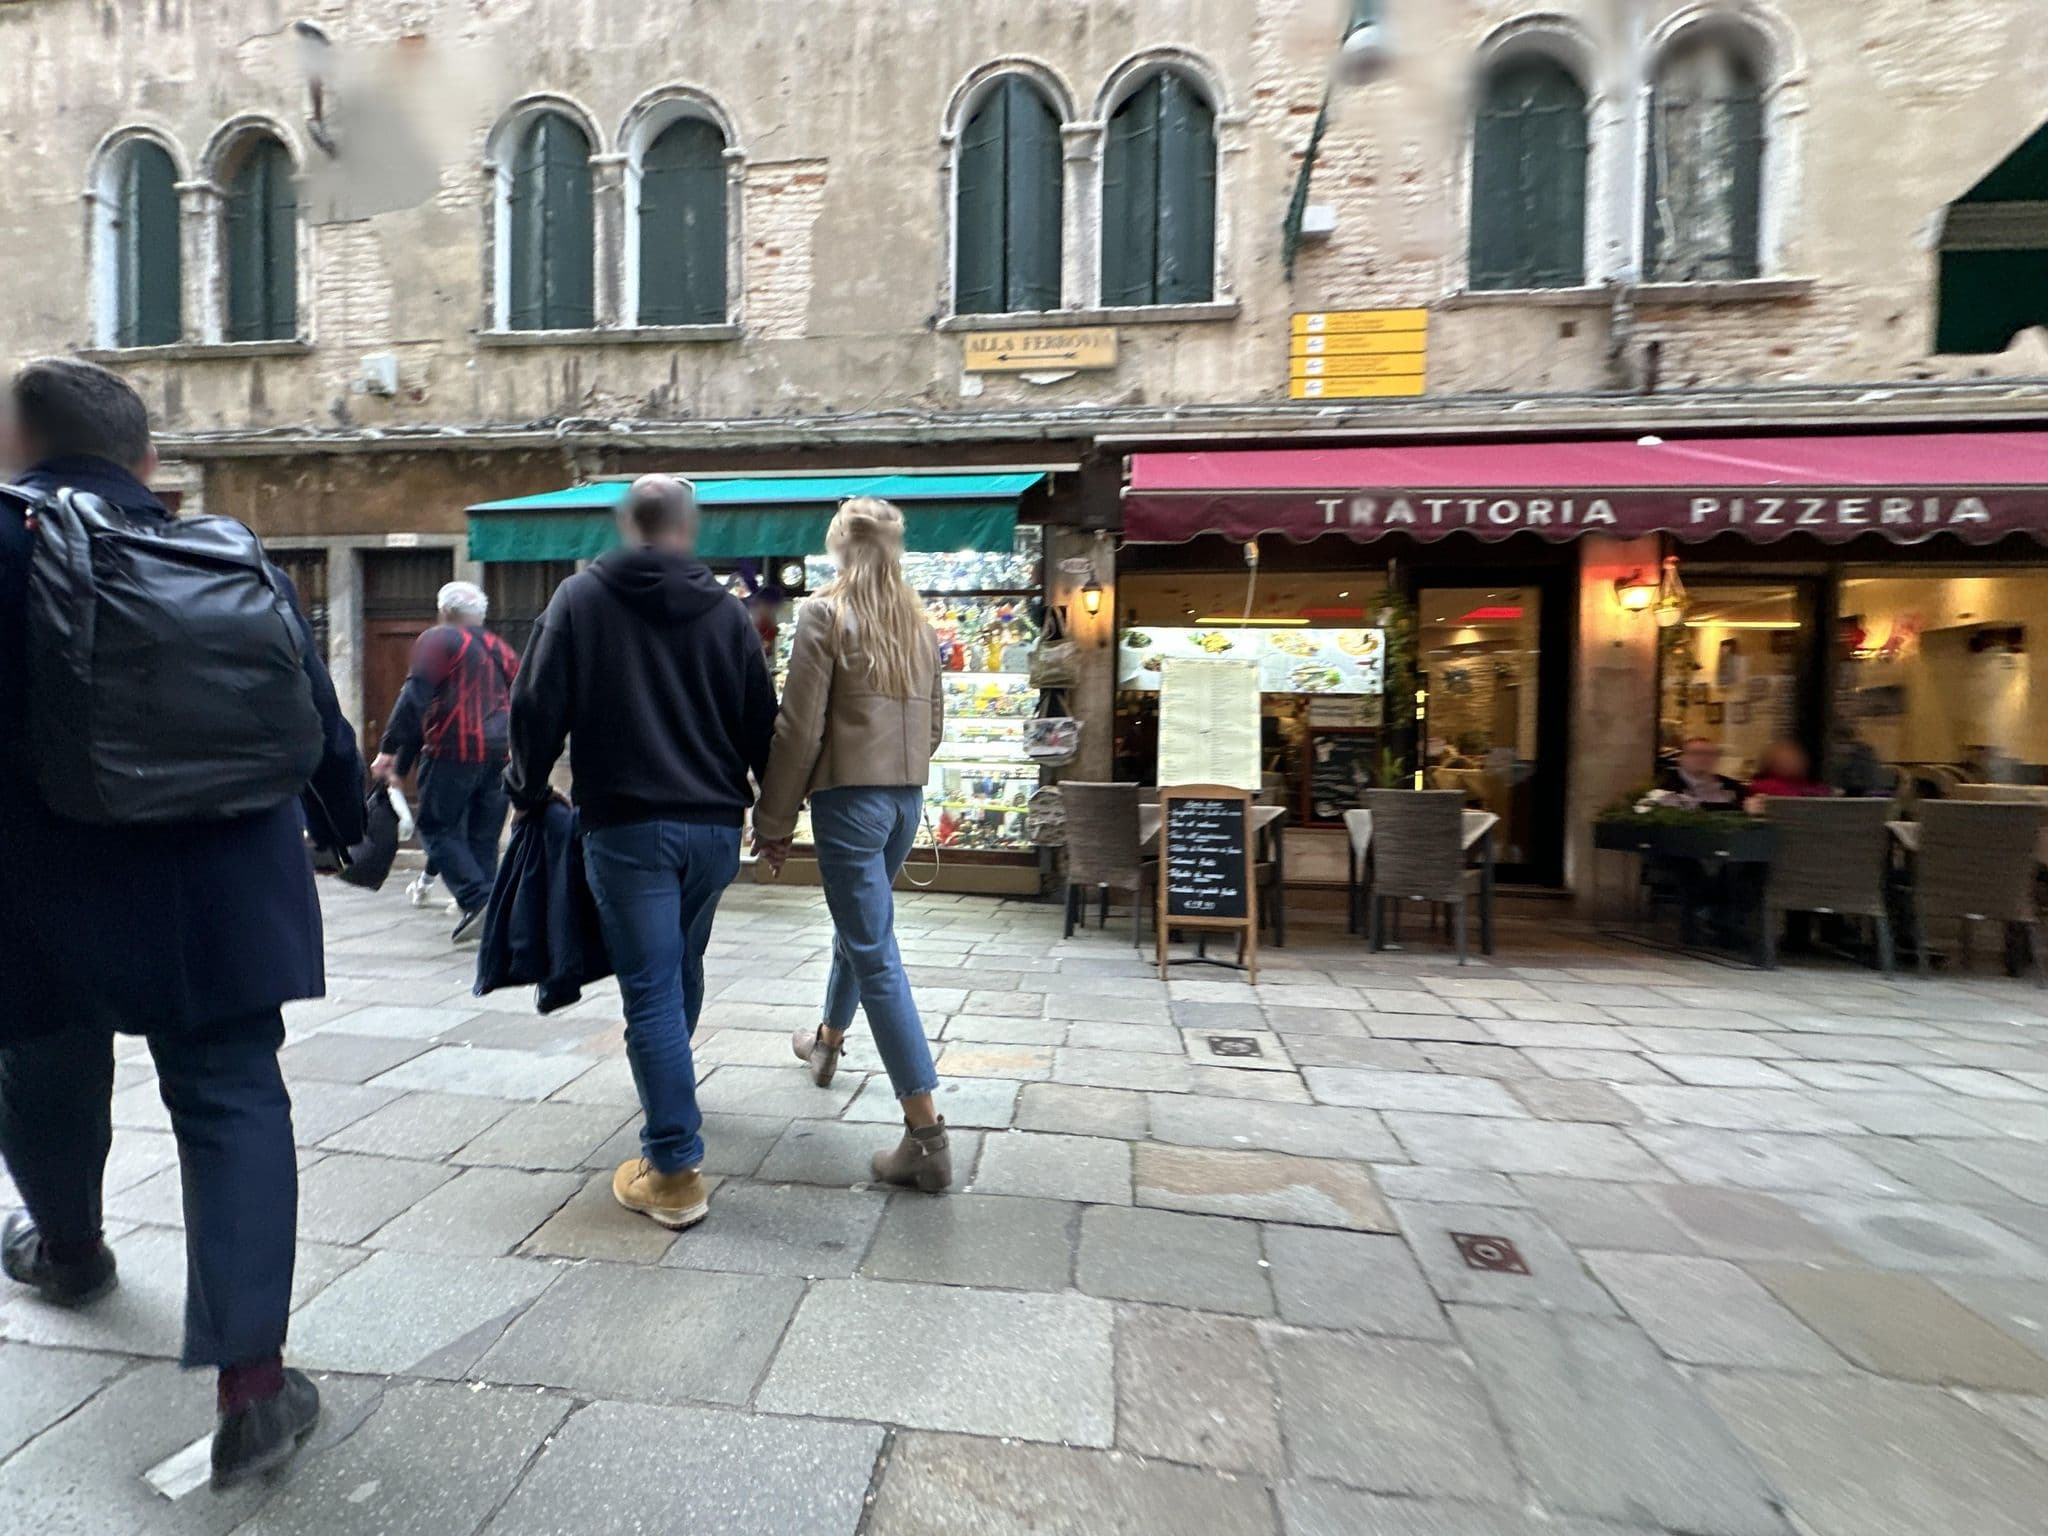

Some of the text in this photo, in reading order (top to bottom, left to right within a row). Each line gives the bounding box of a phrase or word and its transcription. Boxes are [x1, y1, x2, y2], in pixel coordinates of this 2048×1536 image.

[969, 337, 1014, 353] ALLA
[1315, 497, 1991, 526] TRATTORIA PIZZERIA
